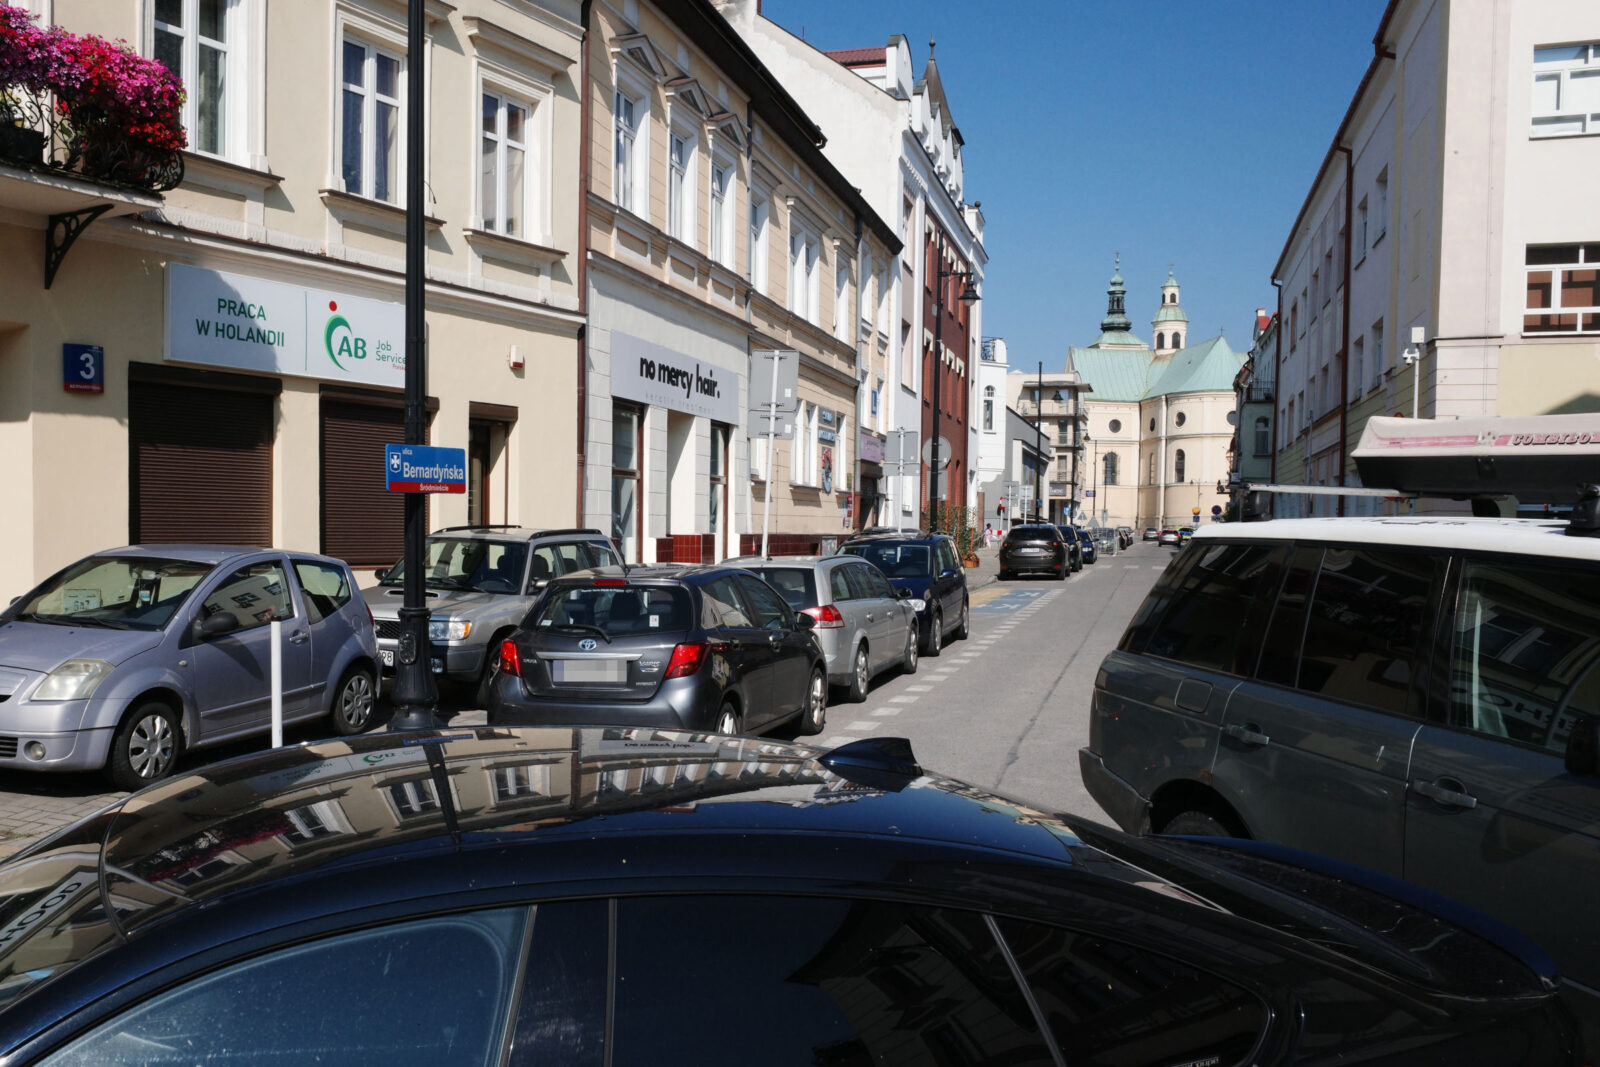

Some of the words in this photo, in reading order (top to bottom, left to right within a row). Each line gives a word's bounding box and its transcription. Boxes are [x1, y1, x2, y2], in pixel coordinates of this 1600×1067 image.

[217, 297, 267, 321] PRACA
[195, 318, 211, 336] W
[215, 321, 285, 347] HOLANDII
[338, 336, 367, 360] AB
[376, 339, 392, 352] Job
[80, 352, 95, 380] 3
[640, 357, 656, 381] no
[658, 363, 693, 399] mercy
[696, 363, 721, 399] hair.
[403, 462, 464, 483] Bernardyńska
